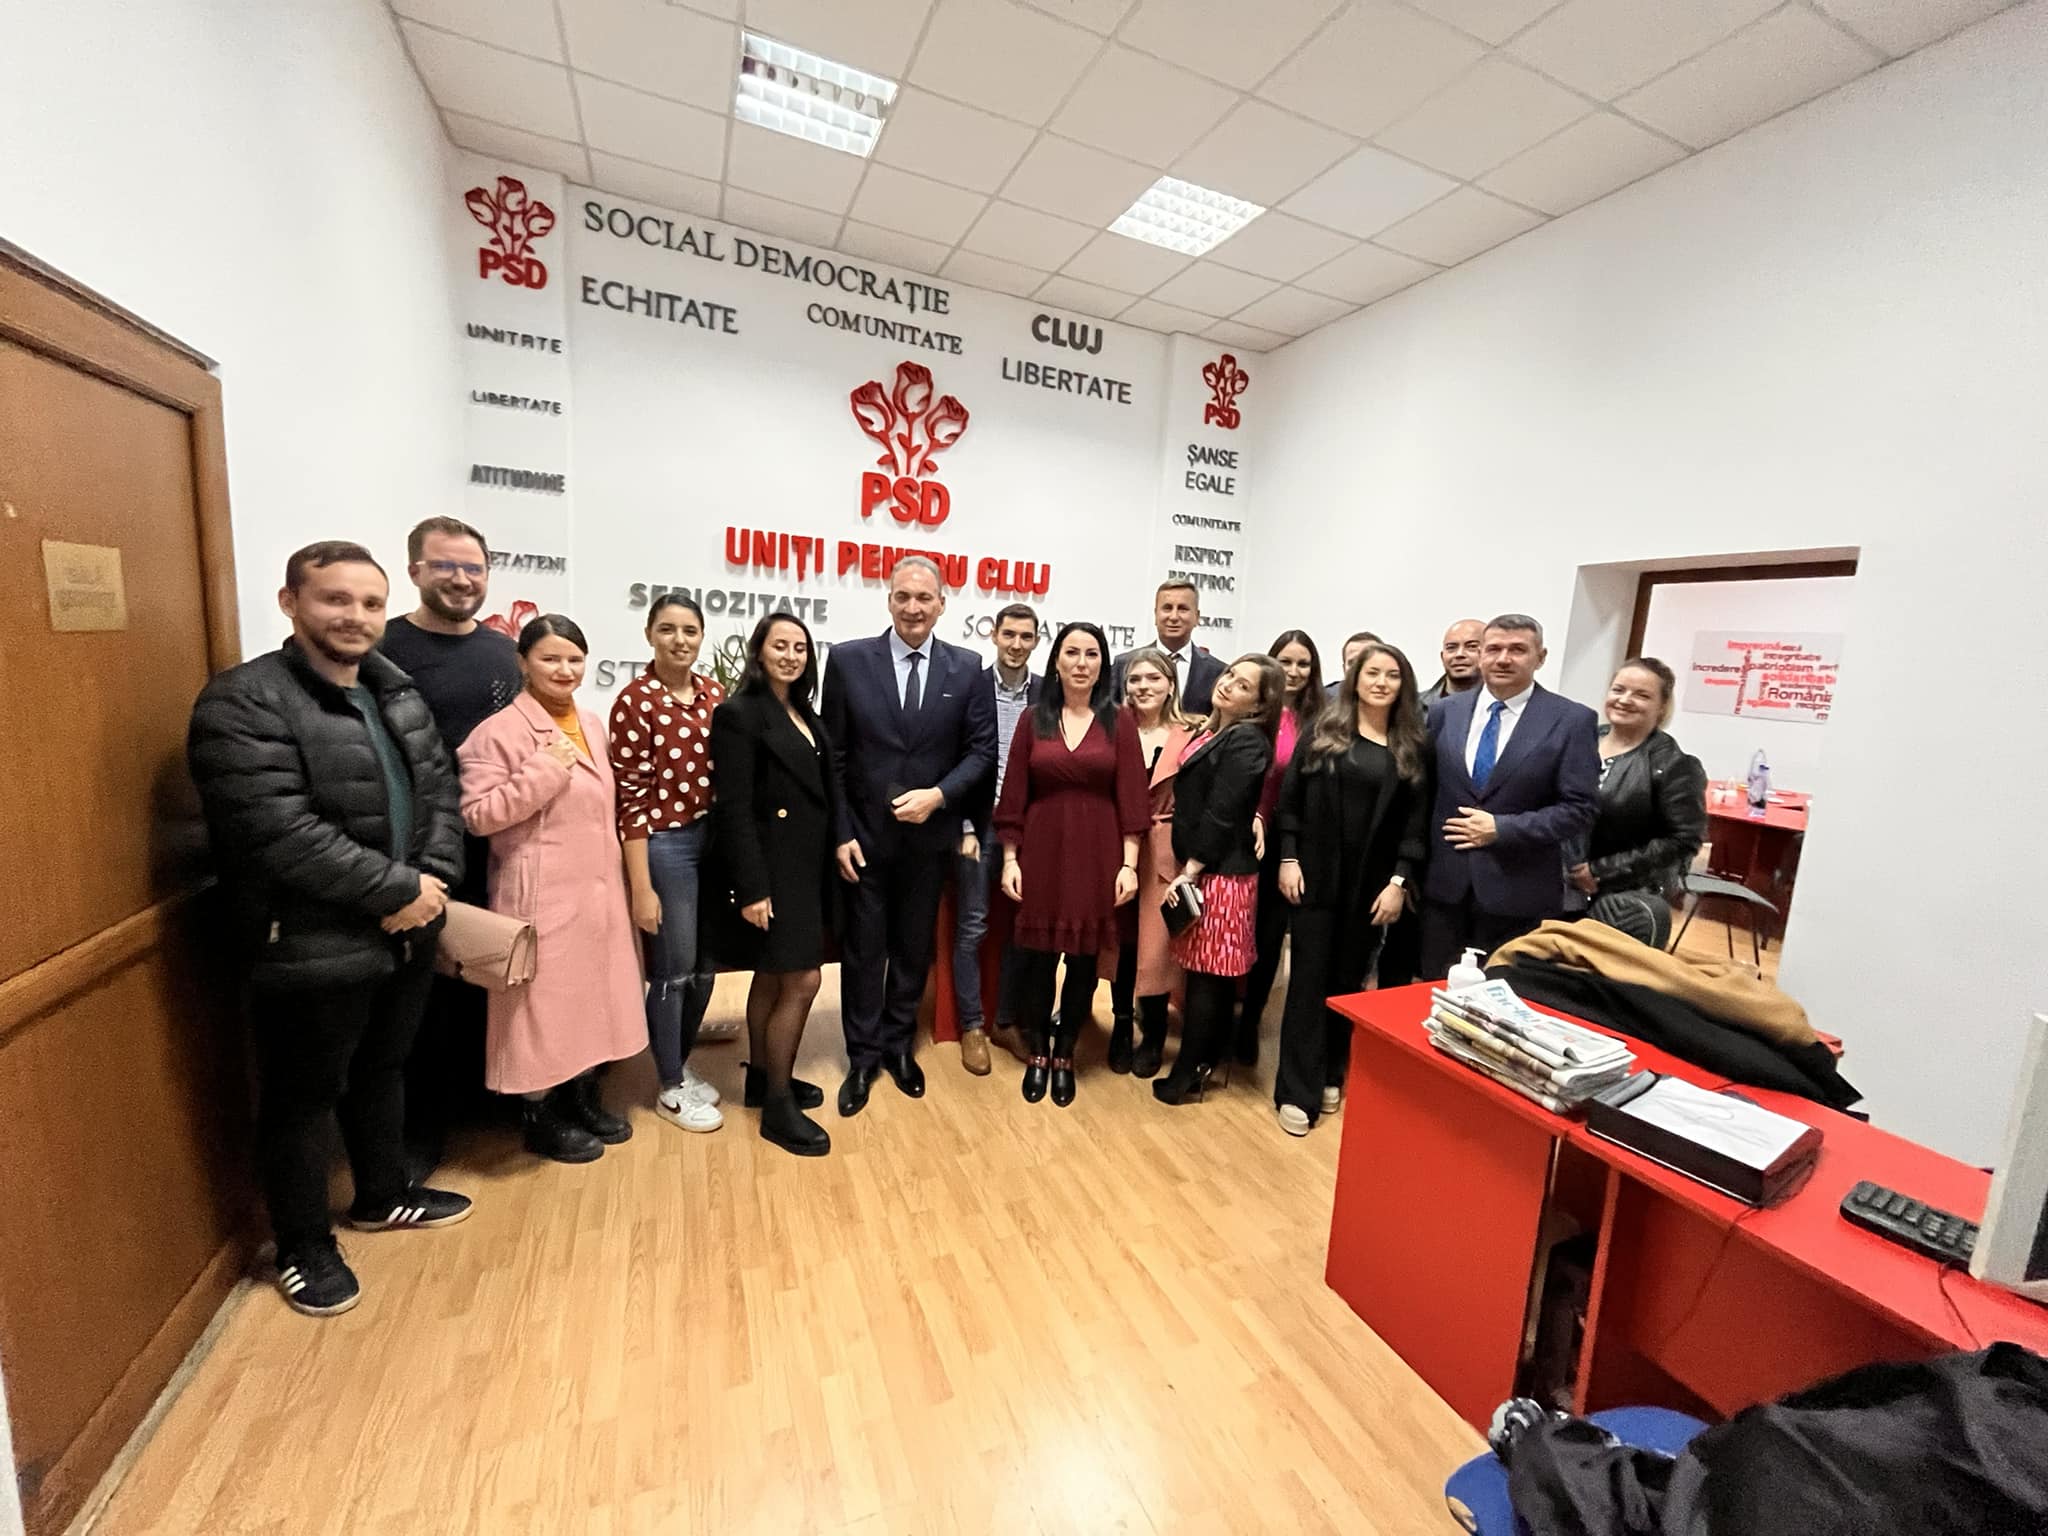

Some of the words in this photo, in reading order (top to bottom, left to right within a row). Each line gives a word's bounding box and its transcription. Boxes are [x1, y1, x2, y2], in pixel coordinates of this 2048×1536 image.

[479, 247, 548, 290] PSD
[584, 201, 725, 261] SOCIAL
[733, 238, 950, 315] DEMOCRAȚIE
[581, 275, 739, 334] ECHITATE
[807, 303, 963, 355] COMUNITATE
[1031, 314, 1104, 355] CLUJ
[1002, 357, 1132, 404] LIBERTATE
[472, 390, 562, 414] LIBERTATE
[1204, 403, 1241, 430] PSD
[471, 464, 565, 493] ATITUDINE
[861, 471, 950, 525] PSD
[1185, 471, 1236, 495] EGALE
[1172, 514, 1241, 531] COMUNITATE
[488, 551, 567, 572] ETATENI
[725, 526, 824, 583] UNIȚI
[837, 540, 968, 588] PENRU
[977, 557, 1051, 595] CLUJ
[1174, 544, 1233, 566] RESPECT
